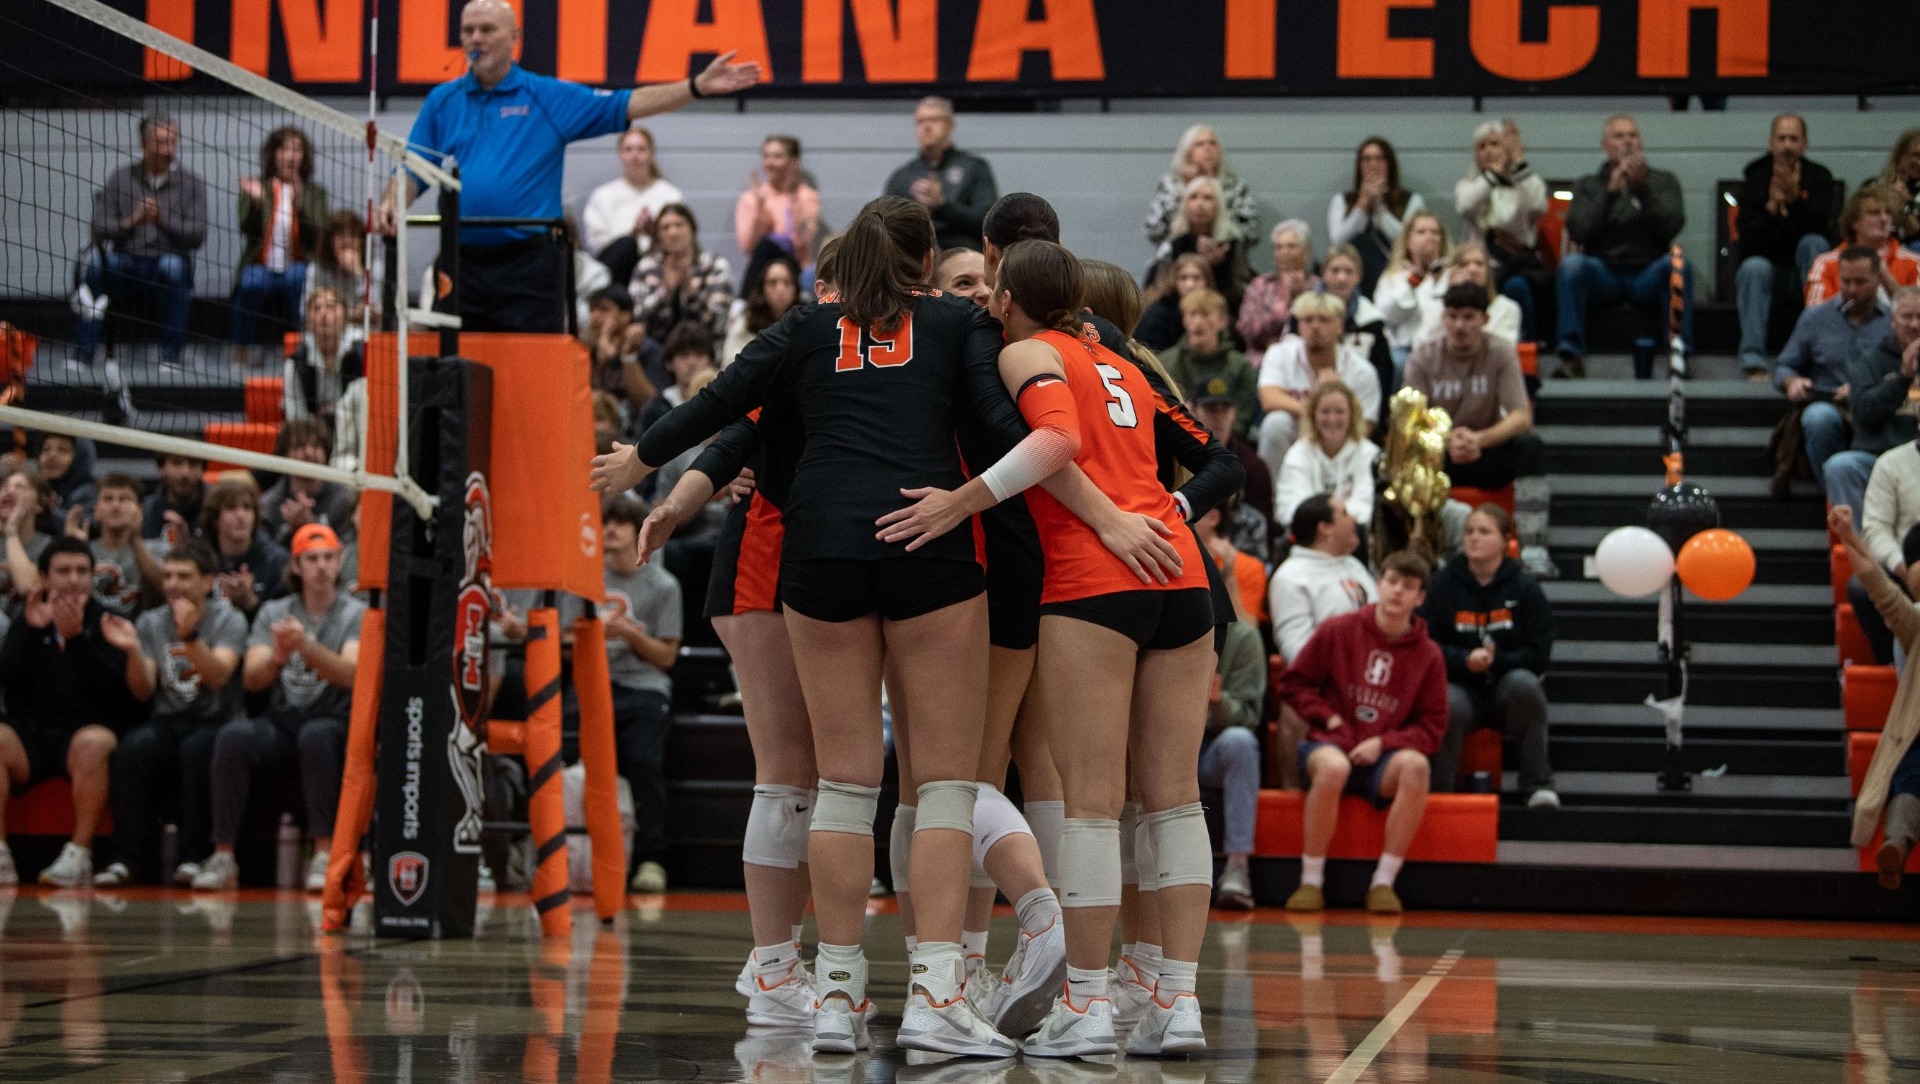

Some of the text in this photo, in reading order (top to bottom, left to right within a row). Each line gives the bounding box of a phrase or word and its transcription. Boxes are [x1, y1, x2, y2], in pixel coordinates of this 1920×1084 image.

[835, 312, 914, 373] 19
[1093, 362, 1139, 429] 5
[402, 696, 424, 840] sports imports
